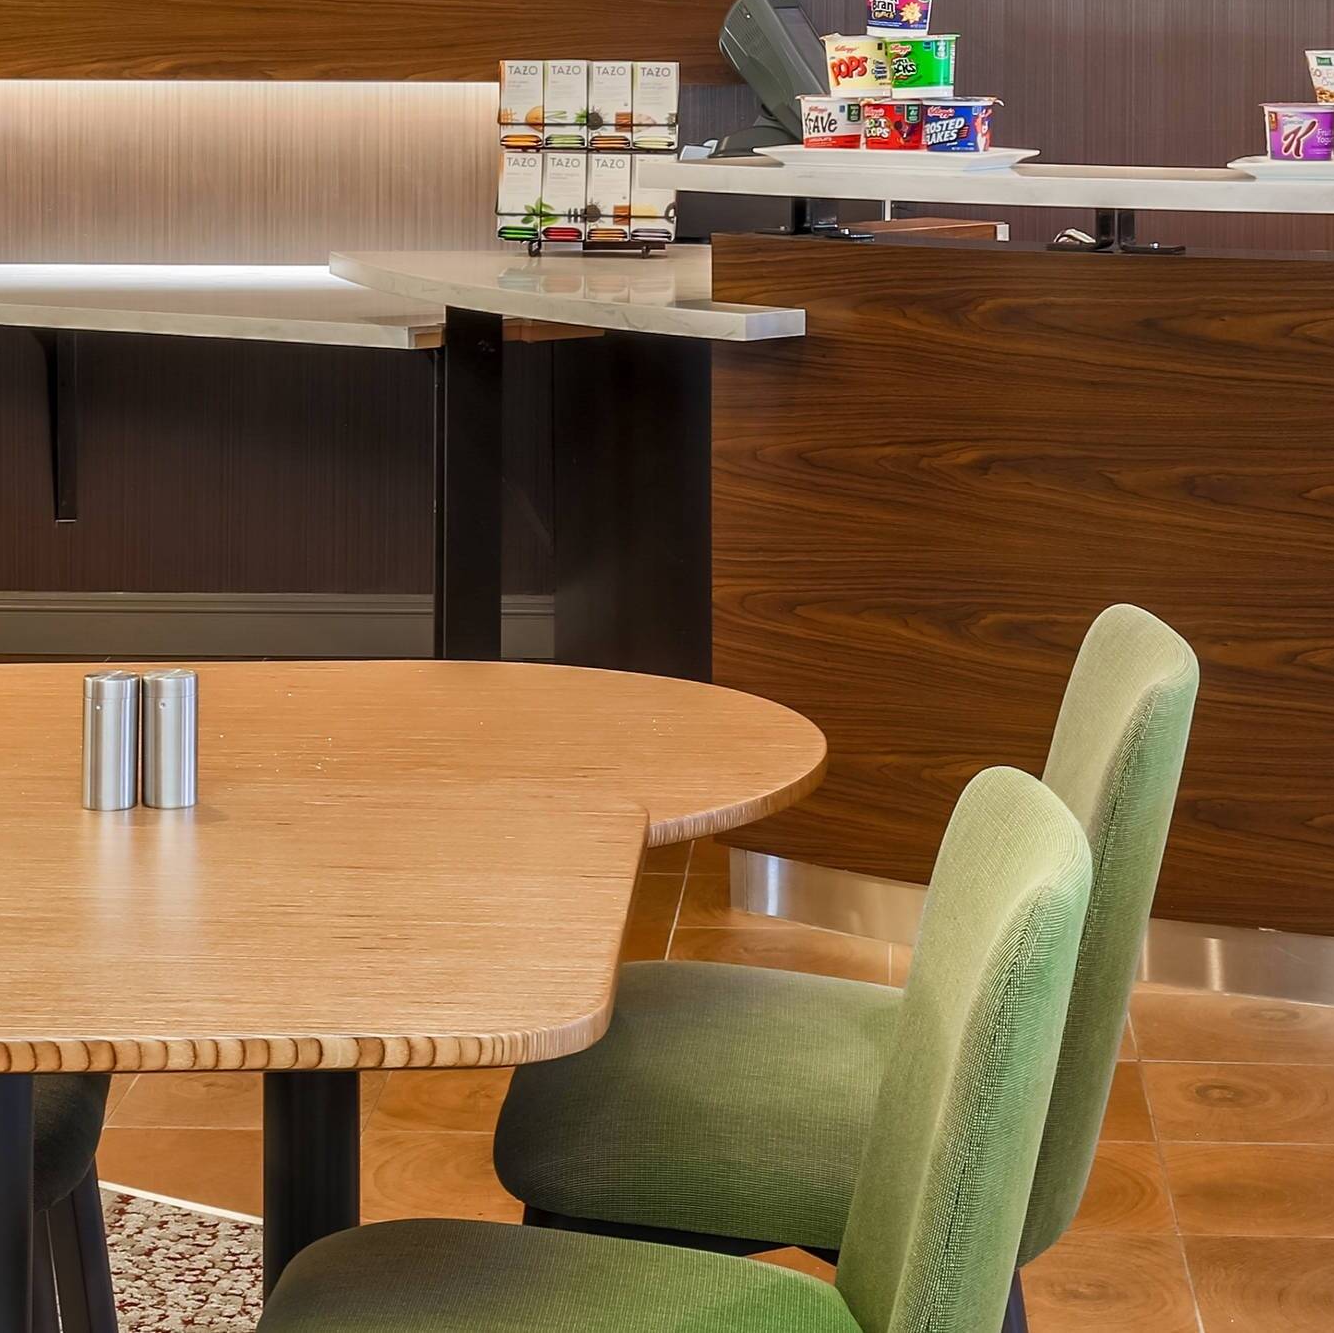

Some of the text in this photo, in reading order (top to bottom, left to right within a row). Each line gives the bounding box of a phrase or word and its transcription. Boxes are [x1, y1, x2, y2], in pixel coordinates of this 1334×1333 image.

[508, 65, 538, 76] TAZO
[551, 65, 581, 75] TAZO
[596, 66, 626, 76] TAZO
[641, 67, 671, 77] TAZO
[507, 157, 537, 167] TAZO
[550, 157, 580, 168] TAZO
[594, 158, 625, 169] TAZO
